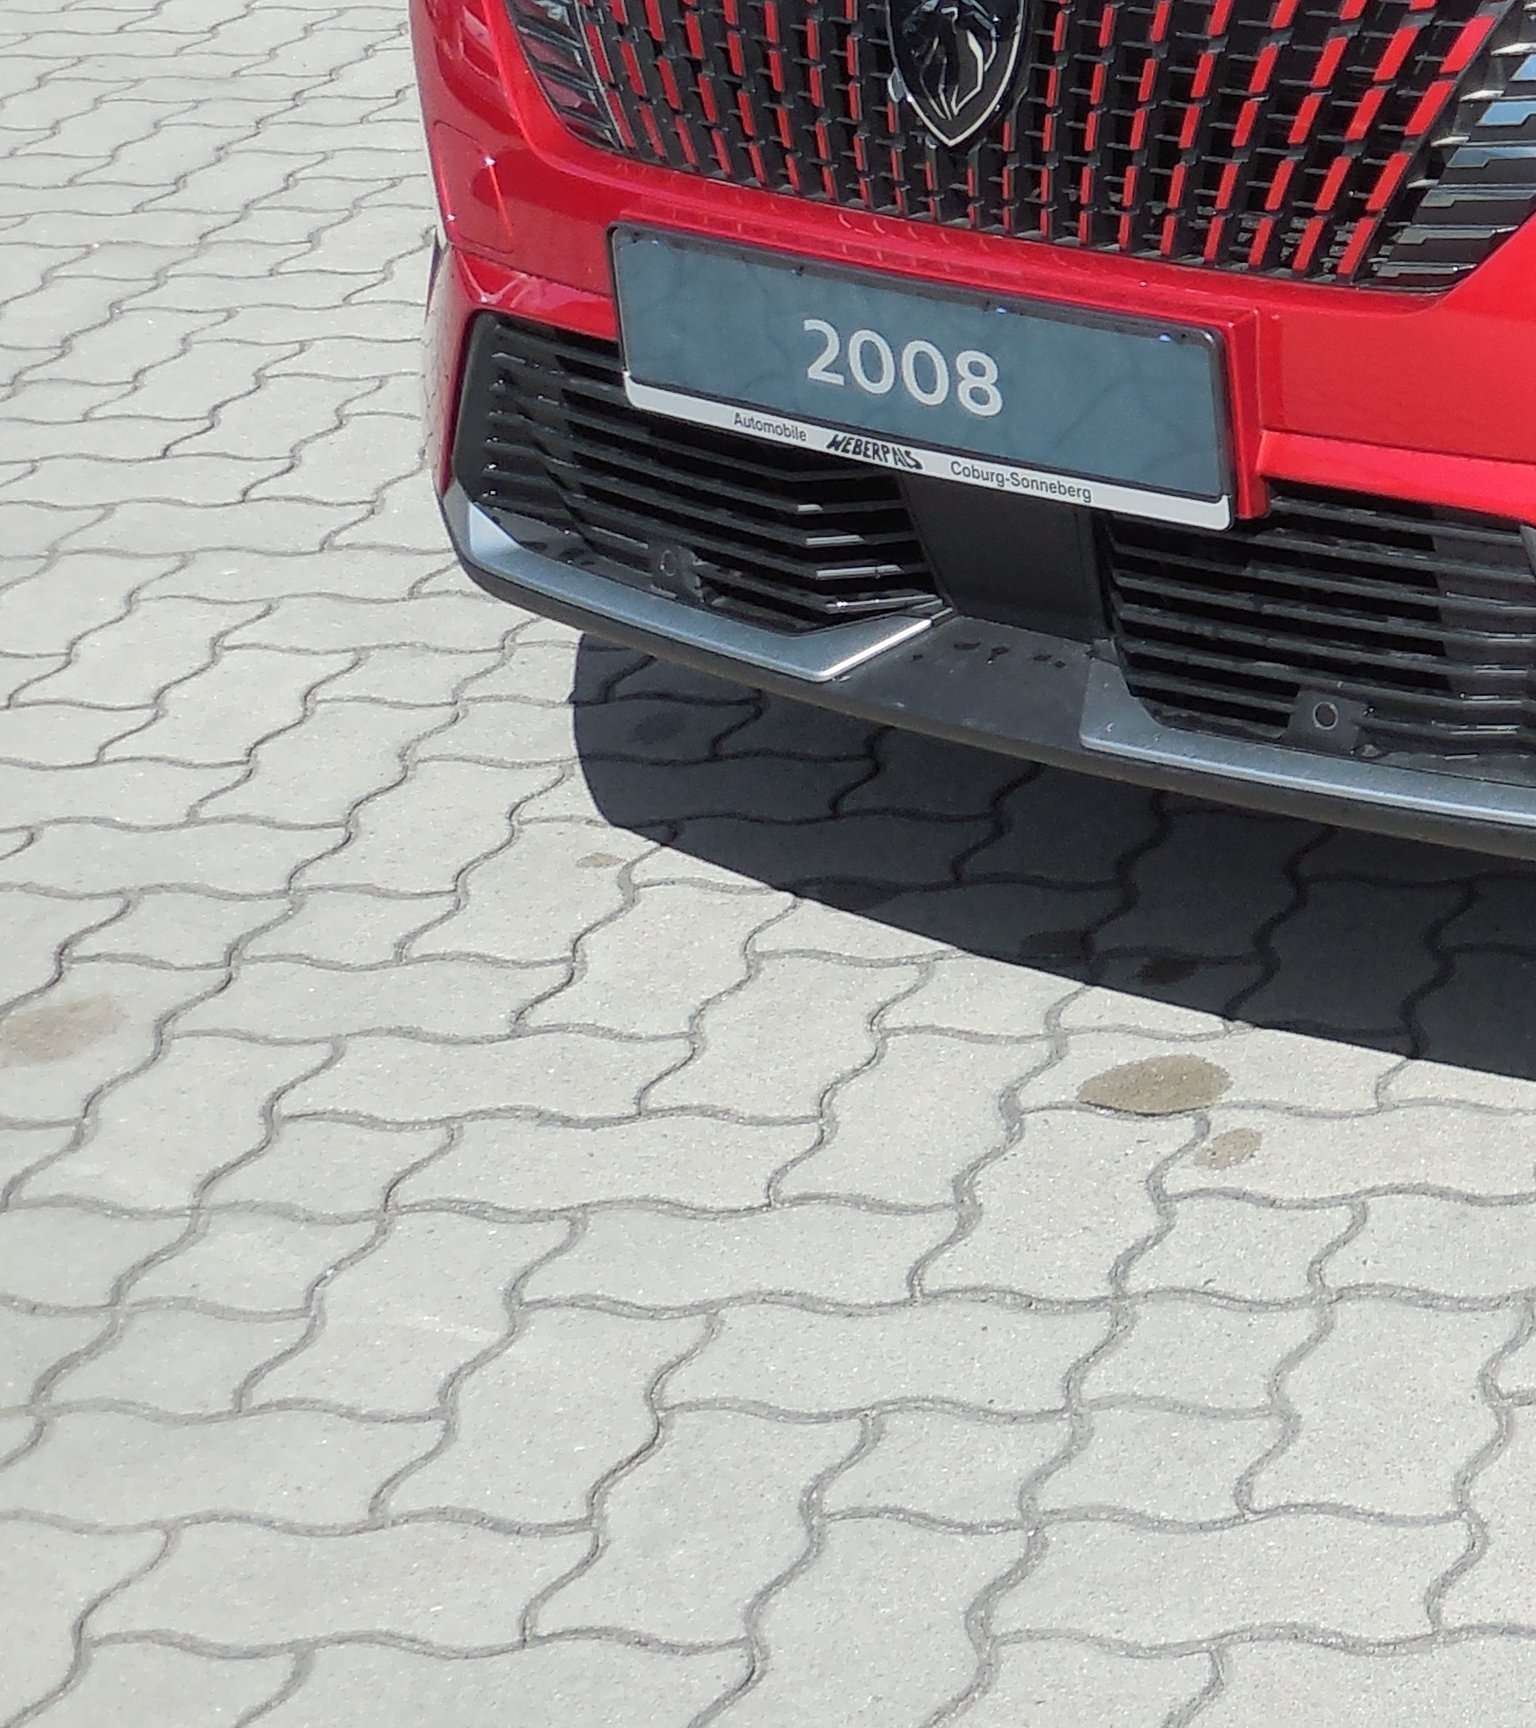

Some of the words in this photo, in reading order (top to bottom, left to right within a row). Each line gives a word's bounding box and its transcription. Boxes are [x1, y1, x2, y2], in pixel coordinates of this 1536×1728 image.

[802, 318, 1005, 417] 2008
[733, 411, 808, 443] Automobile
[825, 432, 925, 471] WEBERPALS
[950, 459, 1093, 504] Coburg-Sonneberg
